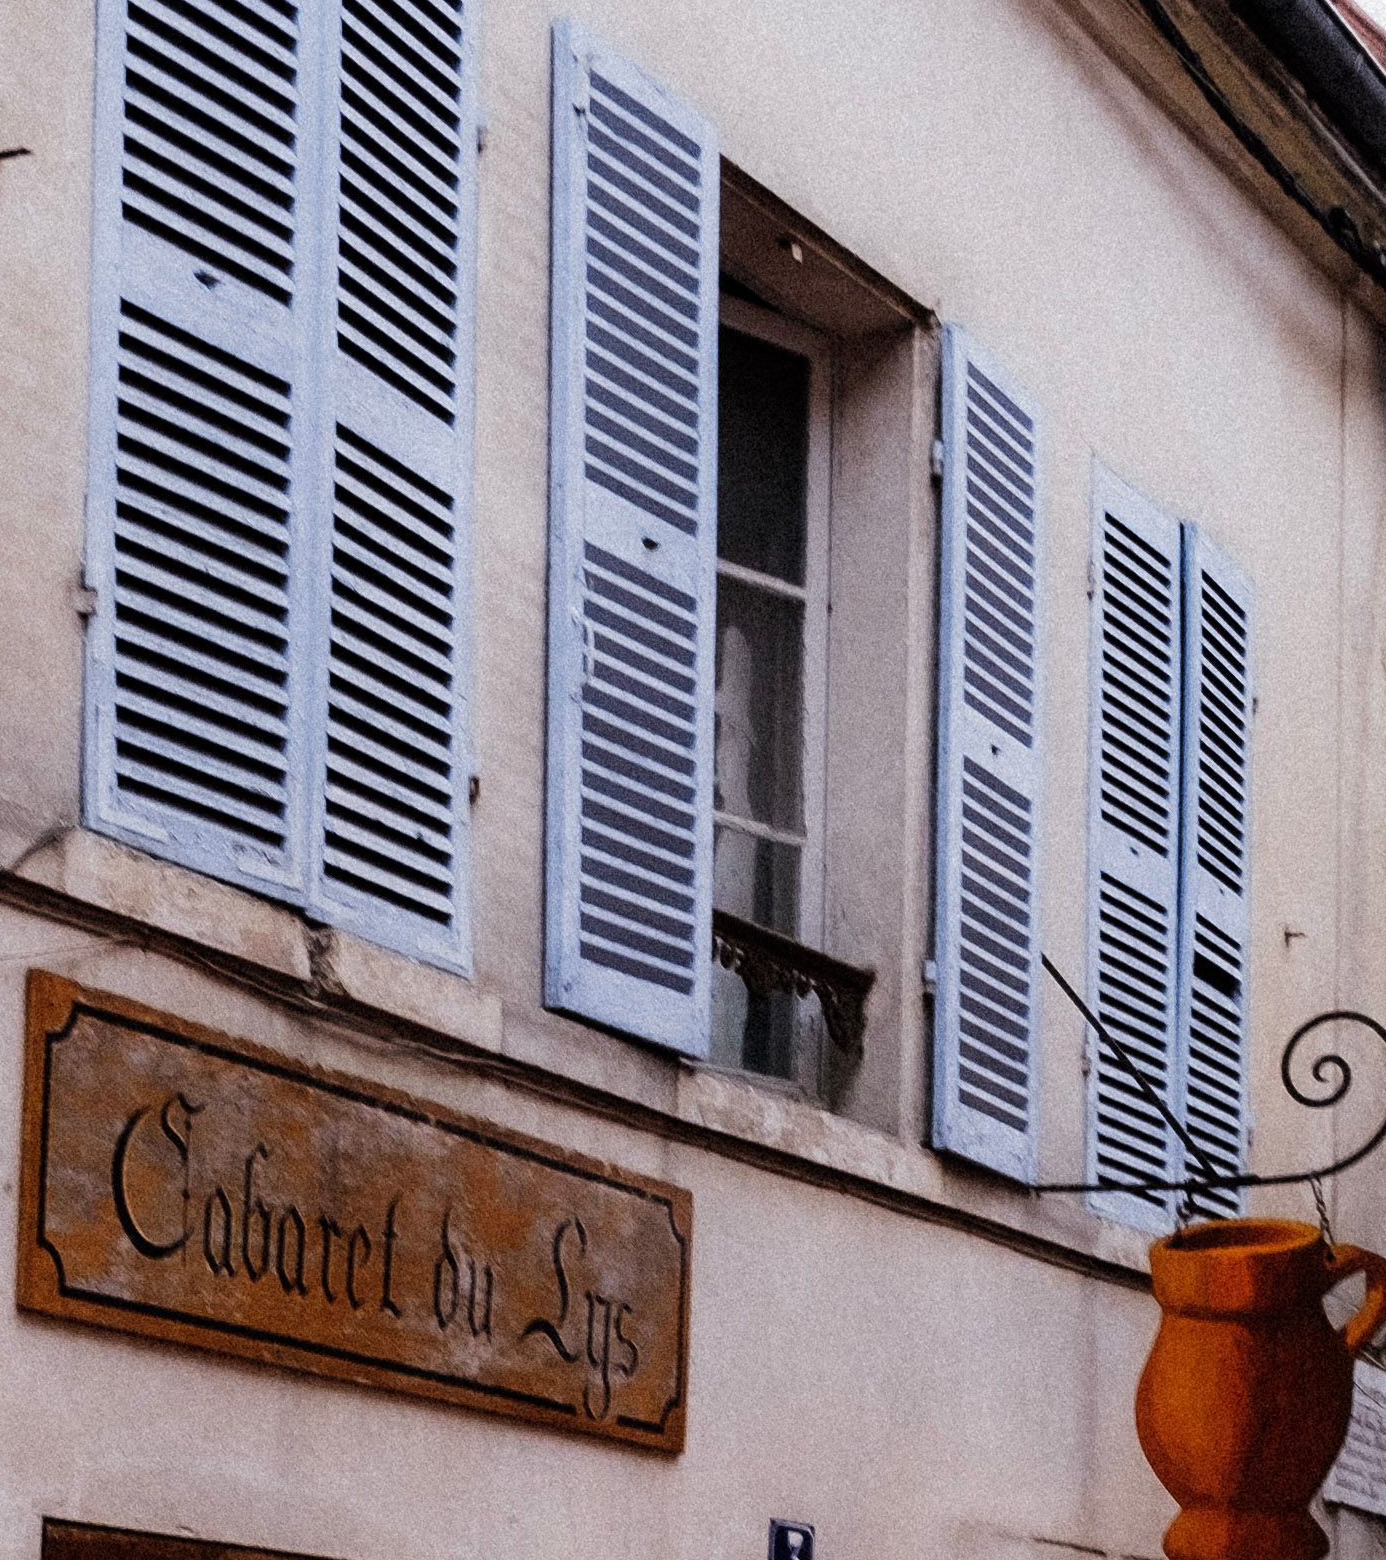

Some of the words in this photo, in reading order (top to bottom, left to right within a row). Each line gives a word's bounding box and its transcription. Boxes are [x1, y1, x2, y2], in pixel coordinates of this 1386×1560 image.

[112, 1092, 403, 1318] Cabaret
[433, 1207, 492, 1343] du
[517, 1215, 638, 1421] Lys
